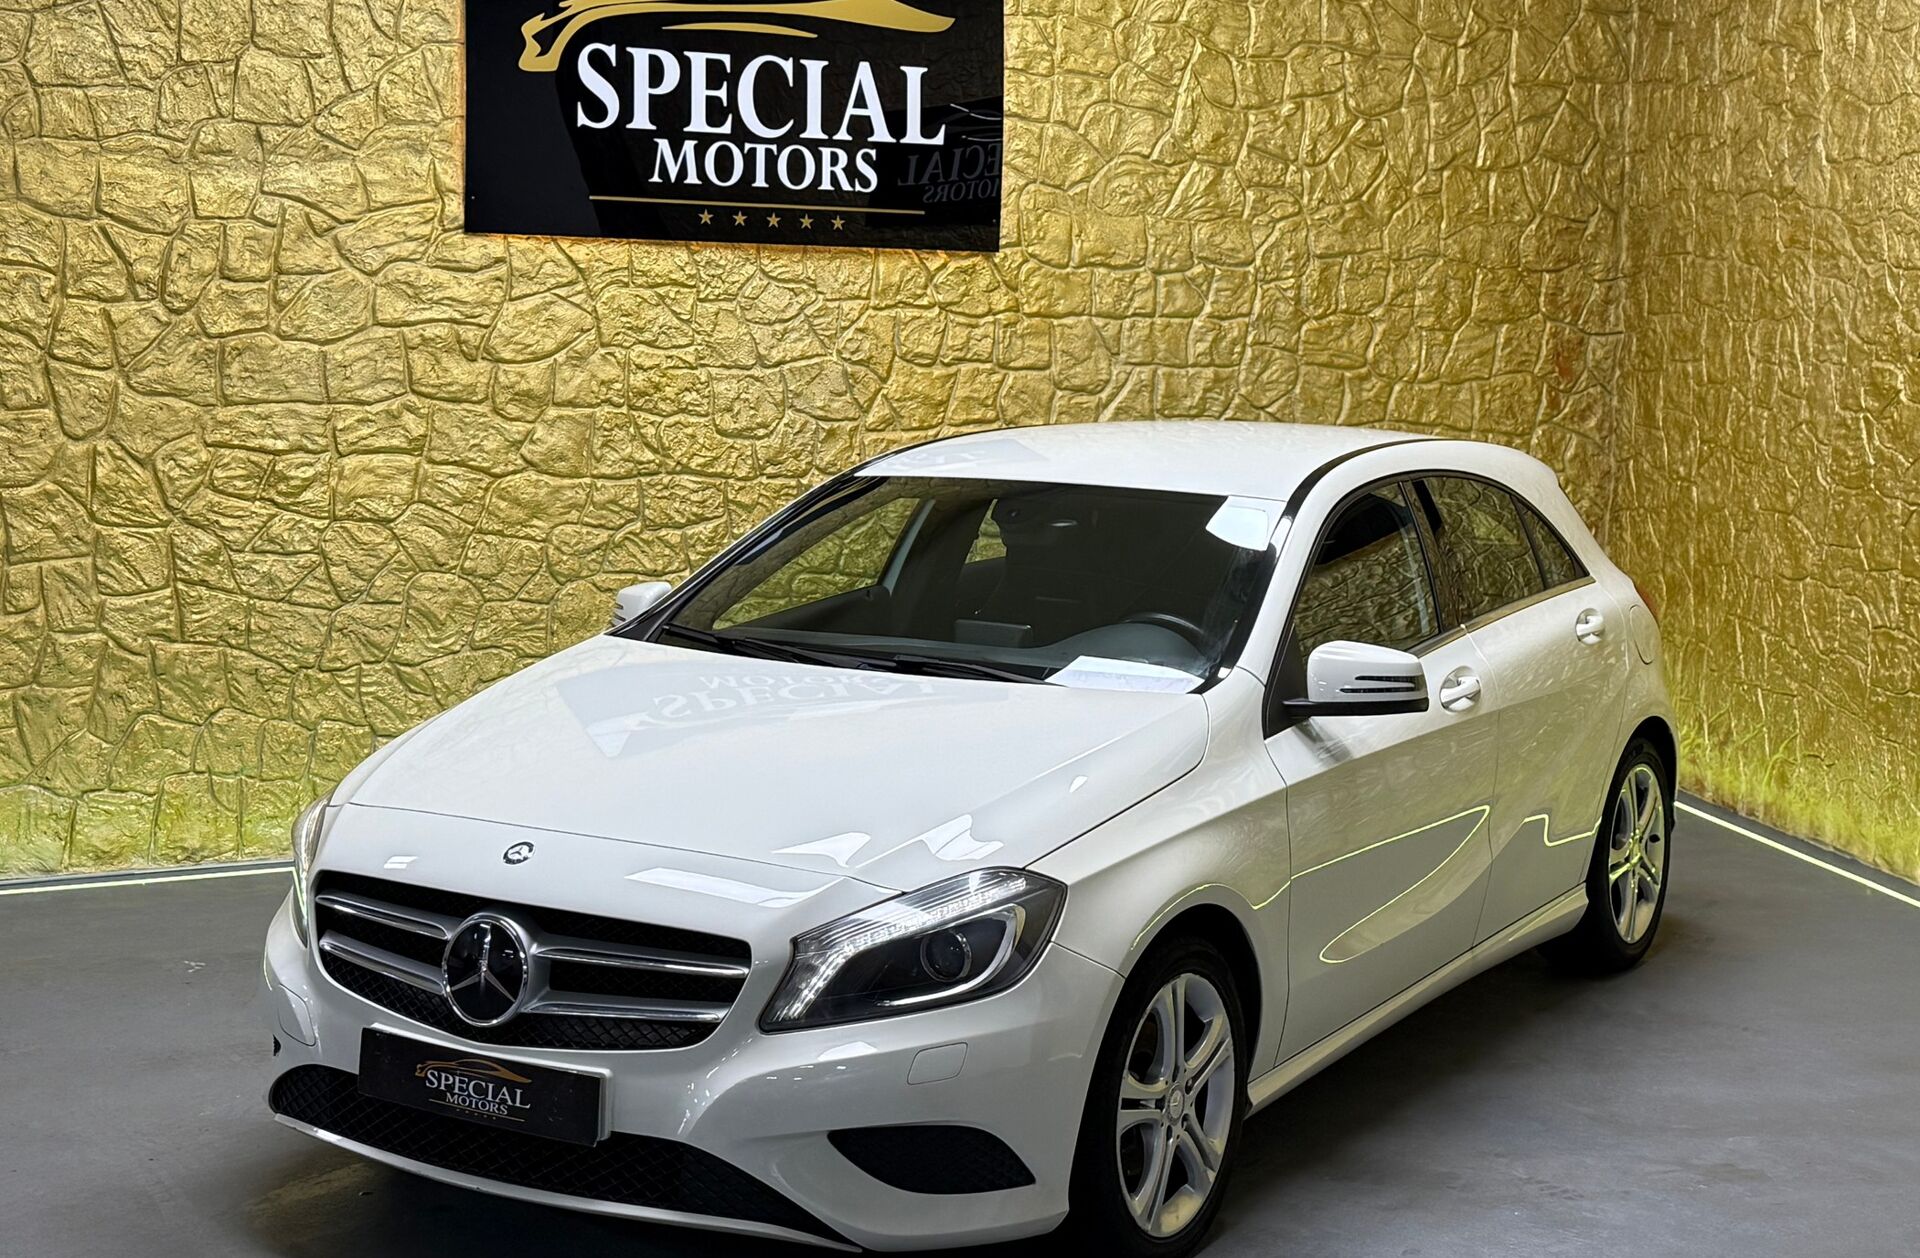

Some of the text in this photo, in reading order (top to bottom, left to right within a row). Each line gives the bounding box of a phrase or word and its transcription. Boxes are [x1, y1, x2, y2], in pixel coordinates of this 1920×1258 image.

[577, 43, 946, 145] SPECIAL
[648, 138, 878, 193] MOTORS
[425, 1069, 531, 1109] SPECIAL
[446, 1092, 508, 1115] MOTORS
